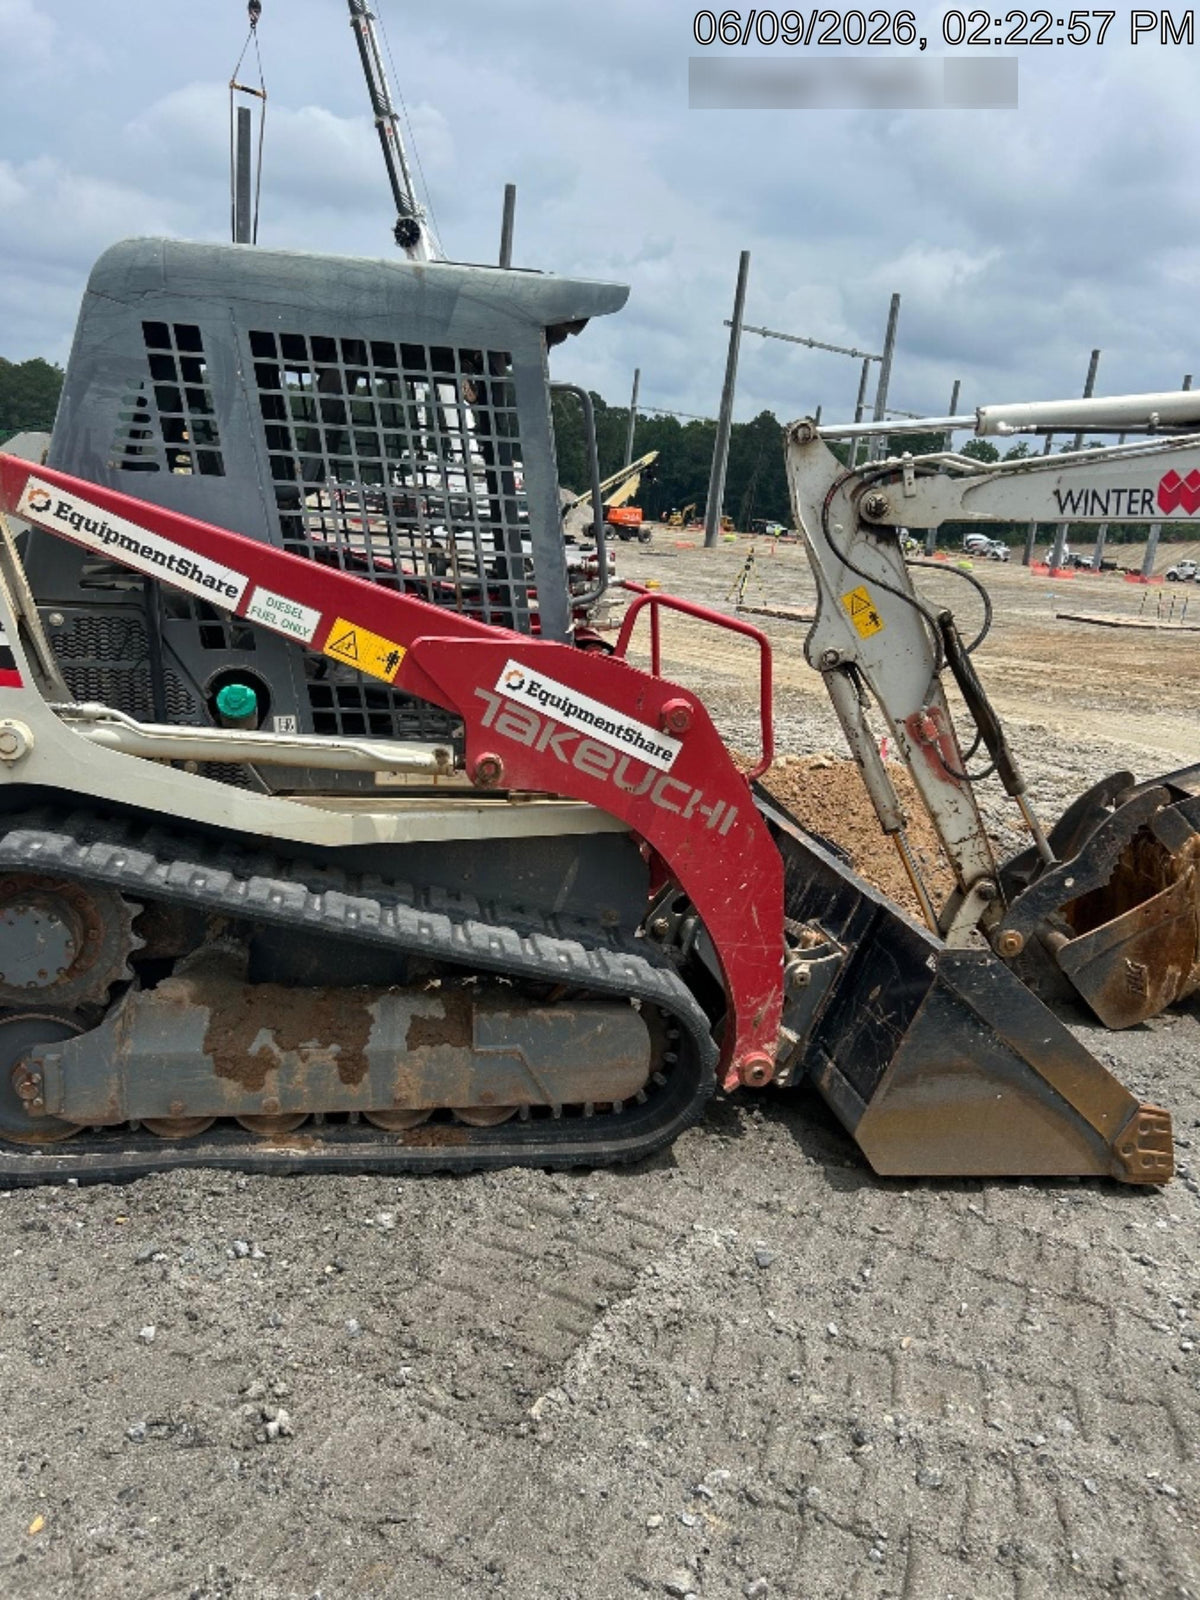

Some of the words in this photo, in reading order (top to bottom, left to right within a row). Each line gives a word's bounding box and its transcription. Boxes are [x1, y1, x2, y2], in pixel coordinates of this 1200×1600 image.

[1053, 488, 1155, 516] WINTER
[53, 500, 239, 599] EquipmentShare
[250, 605, 278, 625] FUEL
[281, 618, 311, 637] ONLY
[265, 596, 304, 620] DIESEL
[525, 678, 673, 762] EquipmentShare
